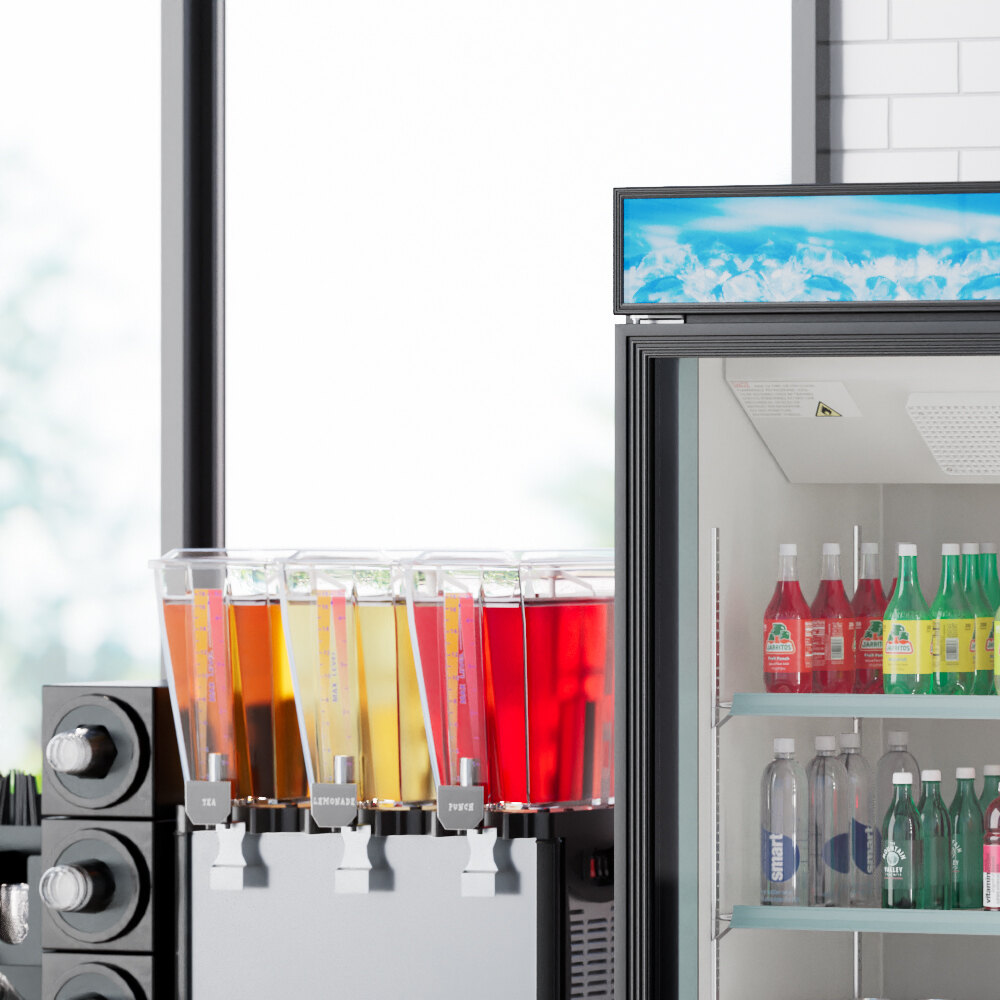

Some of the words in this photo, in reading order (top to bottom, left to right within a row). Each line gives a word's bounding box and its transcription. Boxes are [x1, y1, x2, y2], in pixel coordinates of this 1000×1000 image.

[201, 798, 216, 807] TEA
[314, 798, 356, 807] LEMONADE
[448, 802, 474, 811] PUNCH
[769, 833, 783, 881] smart
